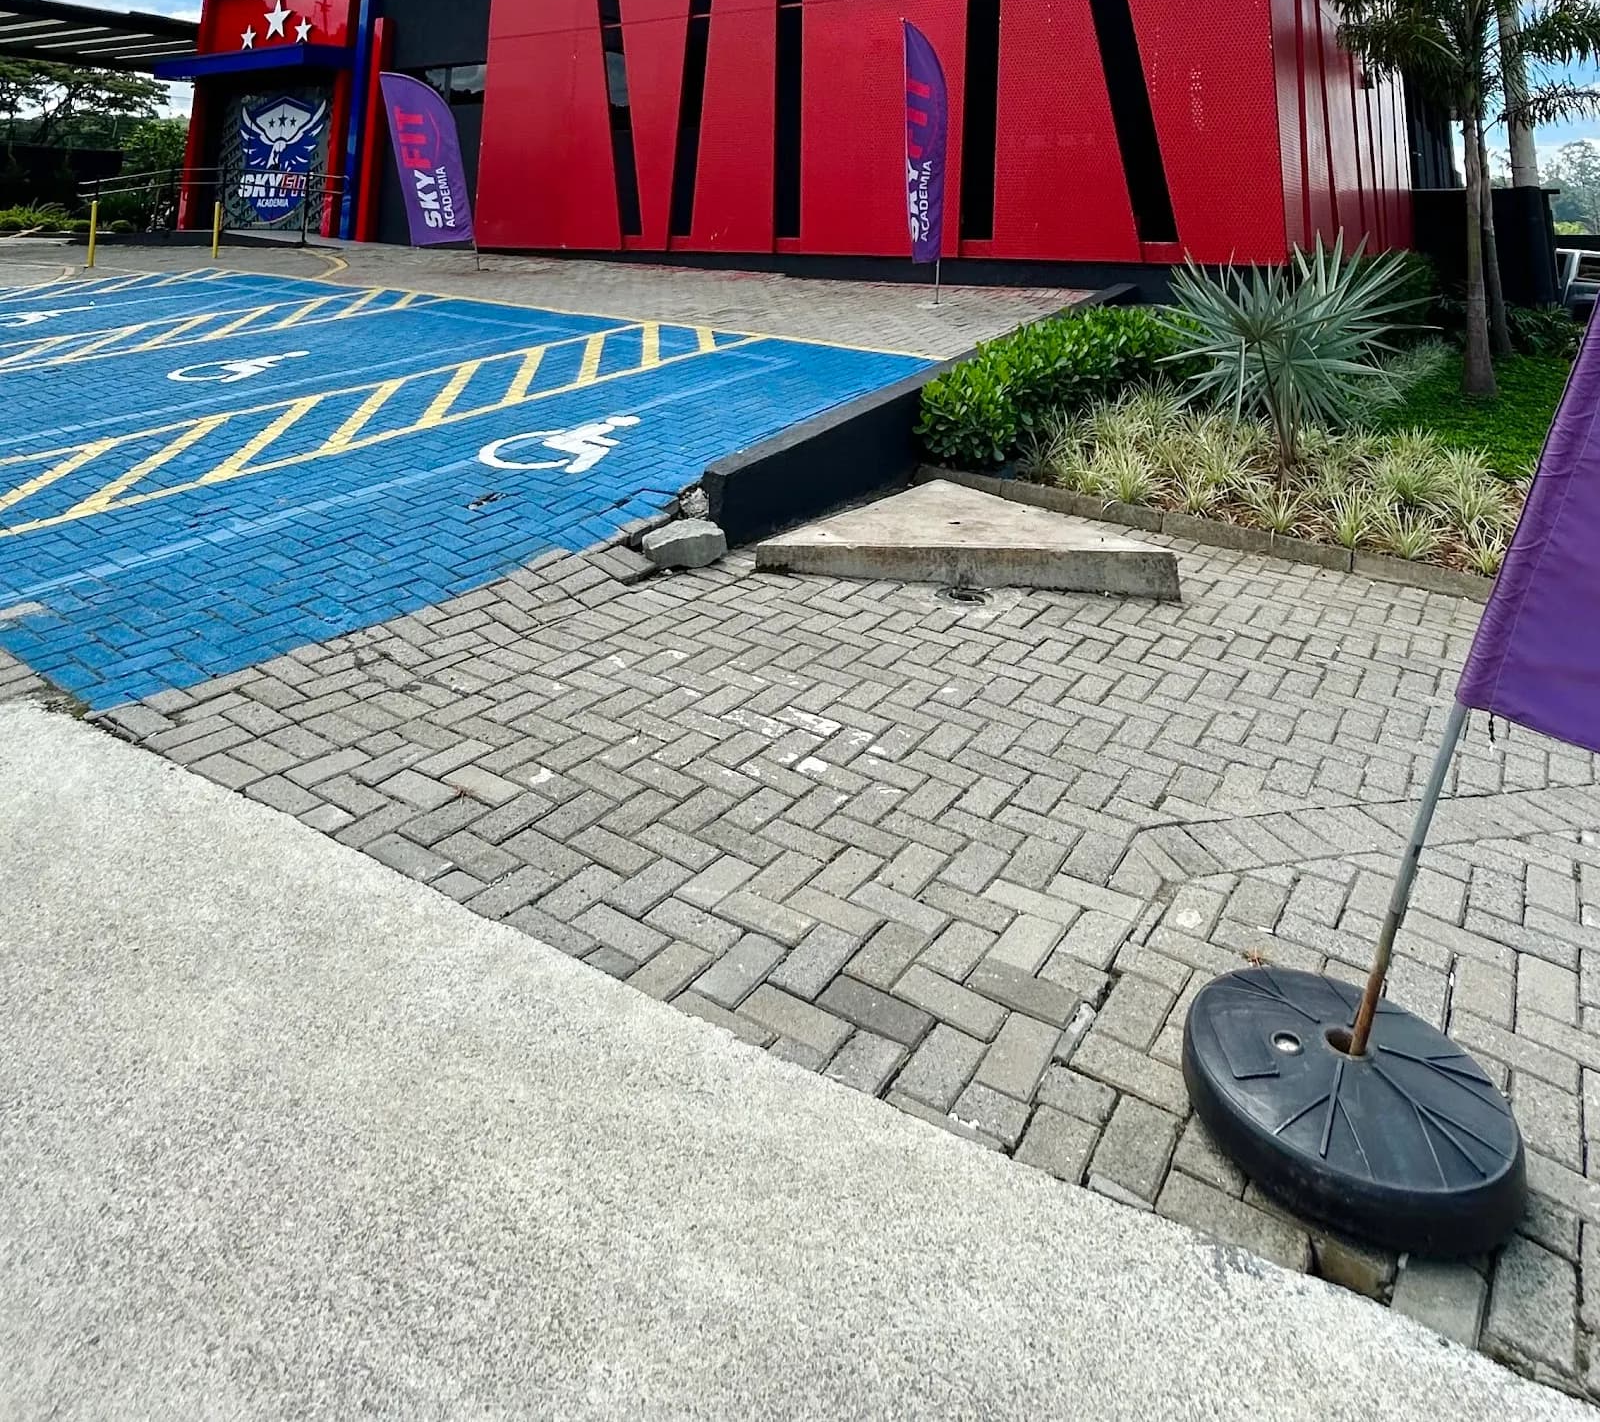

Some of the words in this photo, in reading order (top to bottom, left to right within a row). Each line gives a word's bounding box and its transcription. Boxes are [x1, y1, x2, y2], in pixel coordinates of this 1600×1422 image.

[256, 197, 290, 208] ACADEMIA
[435, 166, 456, 228] ACADEMIA
[919, 160, 932, 242] ACADEMIA
